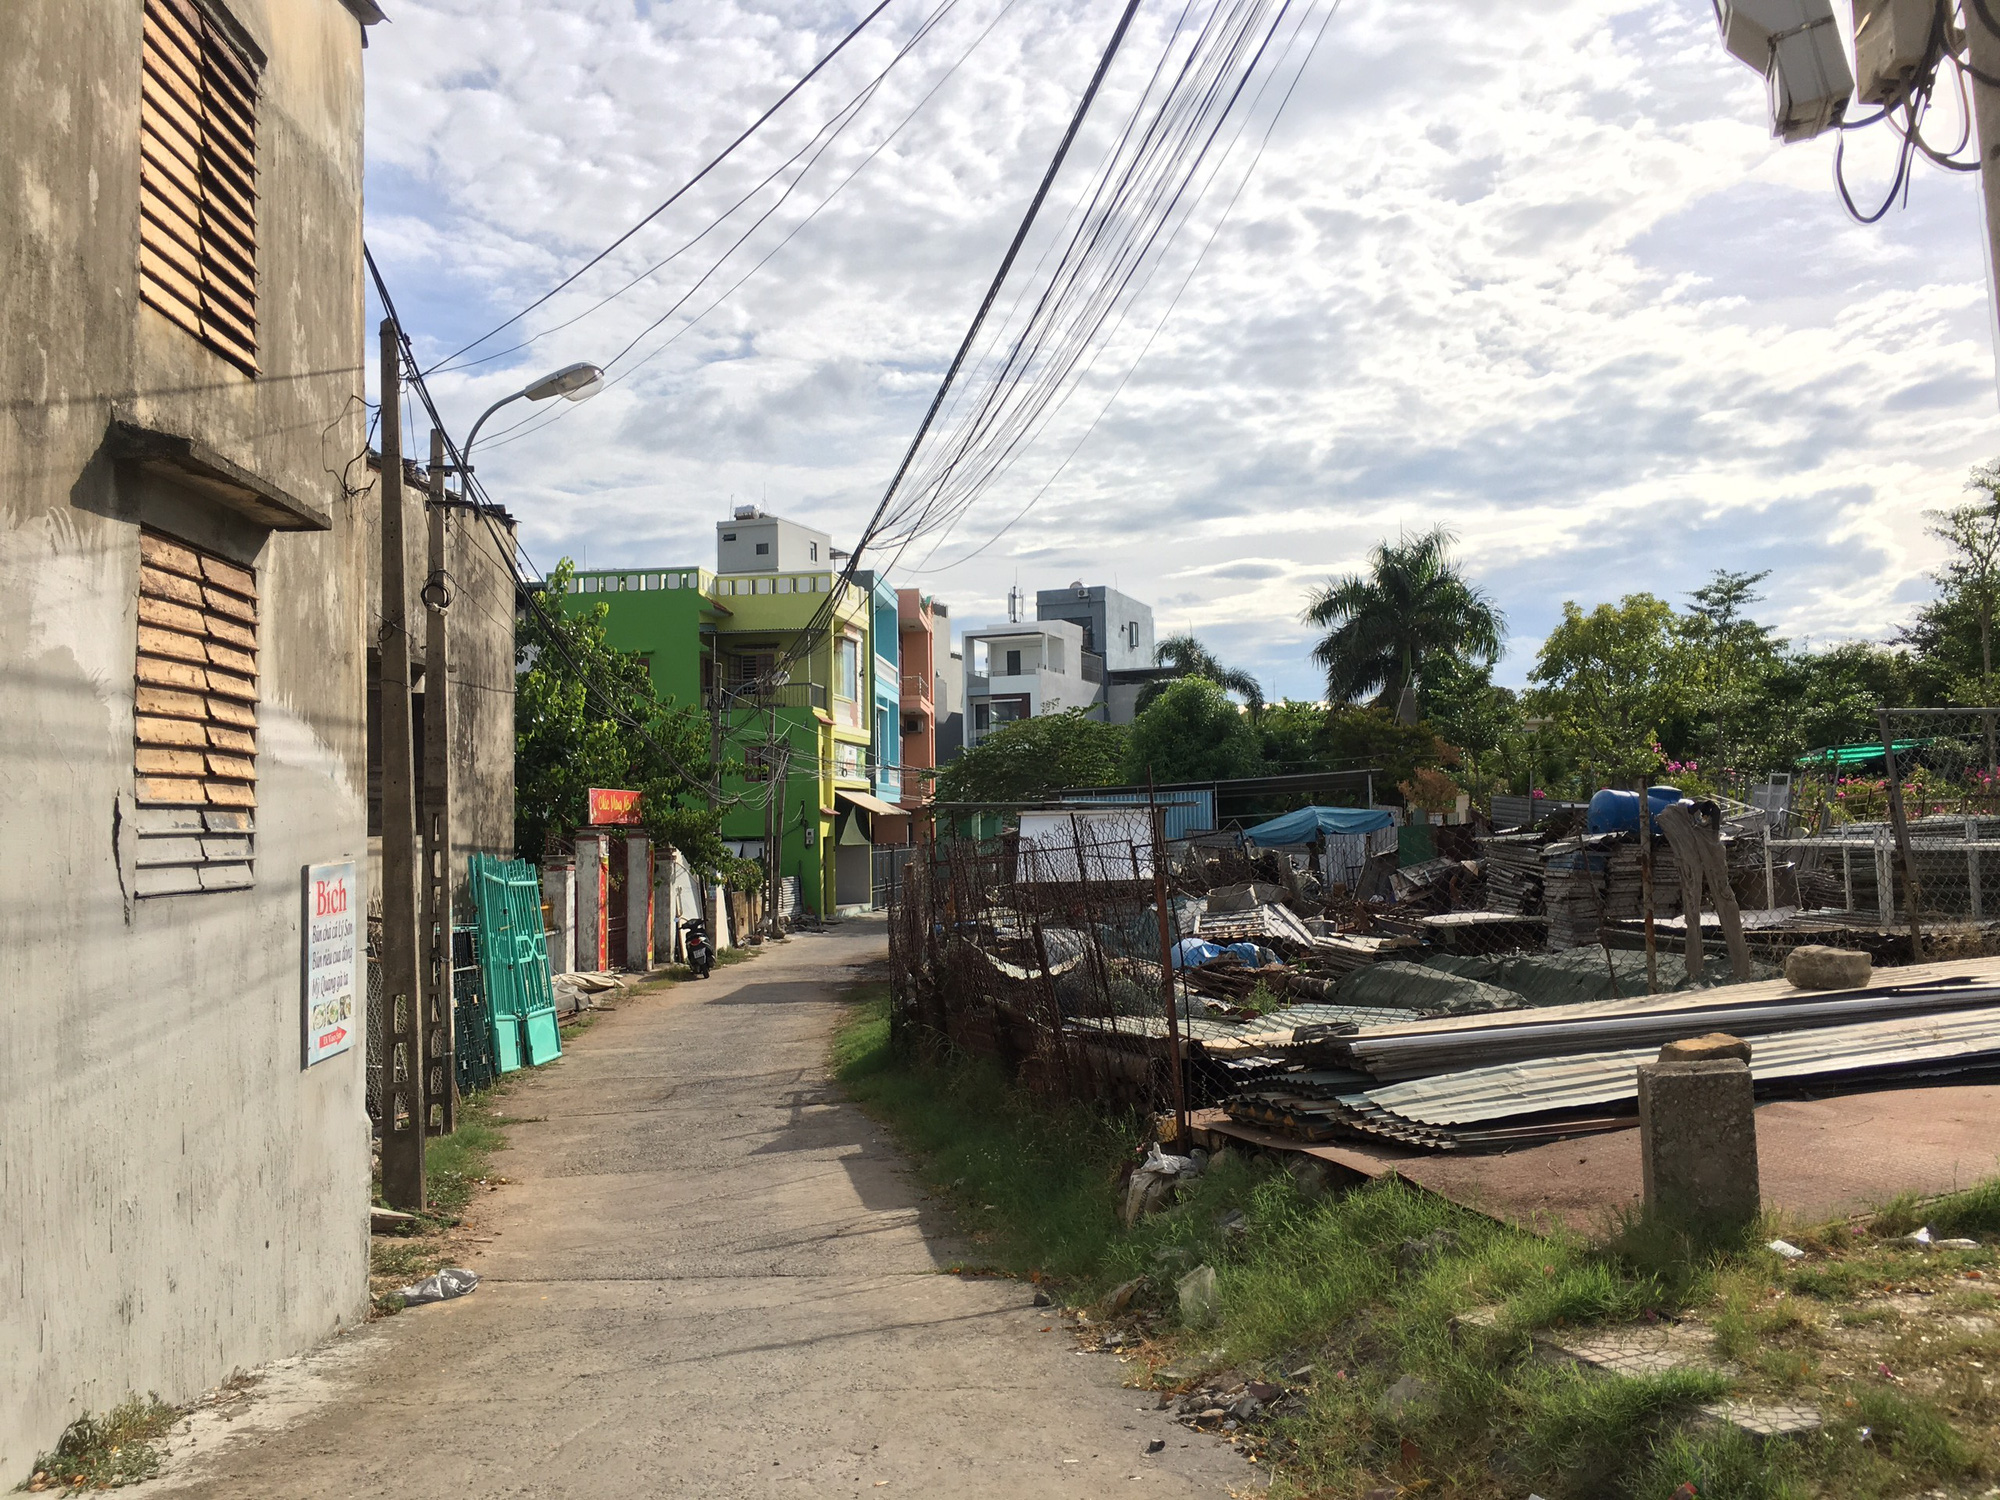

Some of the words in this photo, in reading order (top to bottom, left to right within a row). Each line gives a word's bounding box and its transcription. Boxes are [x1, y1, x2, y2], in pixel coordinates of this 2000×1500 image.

[316, 877, 347, 916] Bích
[312, 924, 322, 944] Bún
[312, 951, 322, 970] Bún
